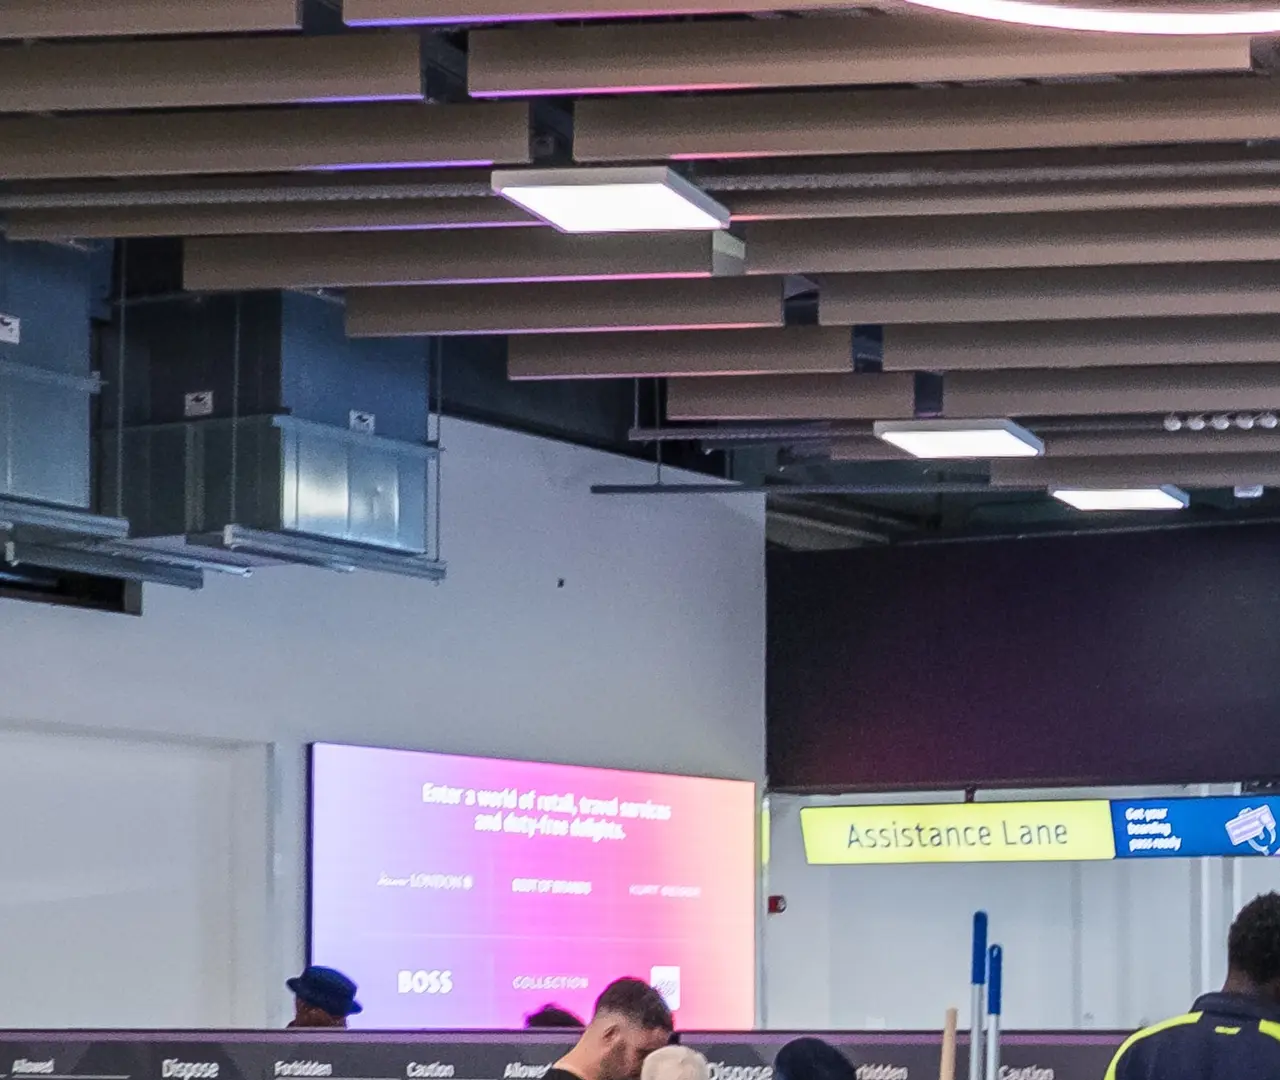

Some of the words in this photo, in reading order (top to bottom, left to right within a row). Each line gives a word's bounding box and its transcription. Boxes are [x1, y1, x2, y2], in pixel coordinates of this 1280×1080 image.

[422, 783, 464, 805] Enter
[464, 789, 476, 806] a
[476, 787, 518, 809] world
[518, 790, 537, 811] of
[474, 811, 502, 831] and
[847, 820, 991, 849] Assistance
[1002, 820, 1069, 847] Lane
[397, 969, 453, 994] BOSS
[162, 1058, 221, 1080] Dispose
[274, 1060, 333, 1077] Forbidden
[406, 1061, 455, 1078] Caution
[856, 1063, 908, 1080] rbidden
